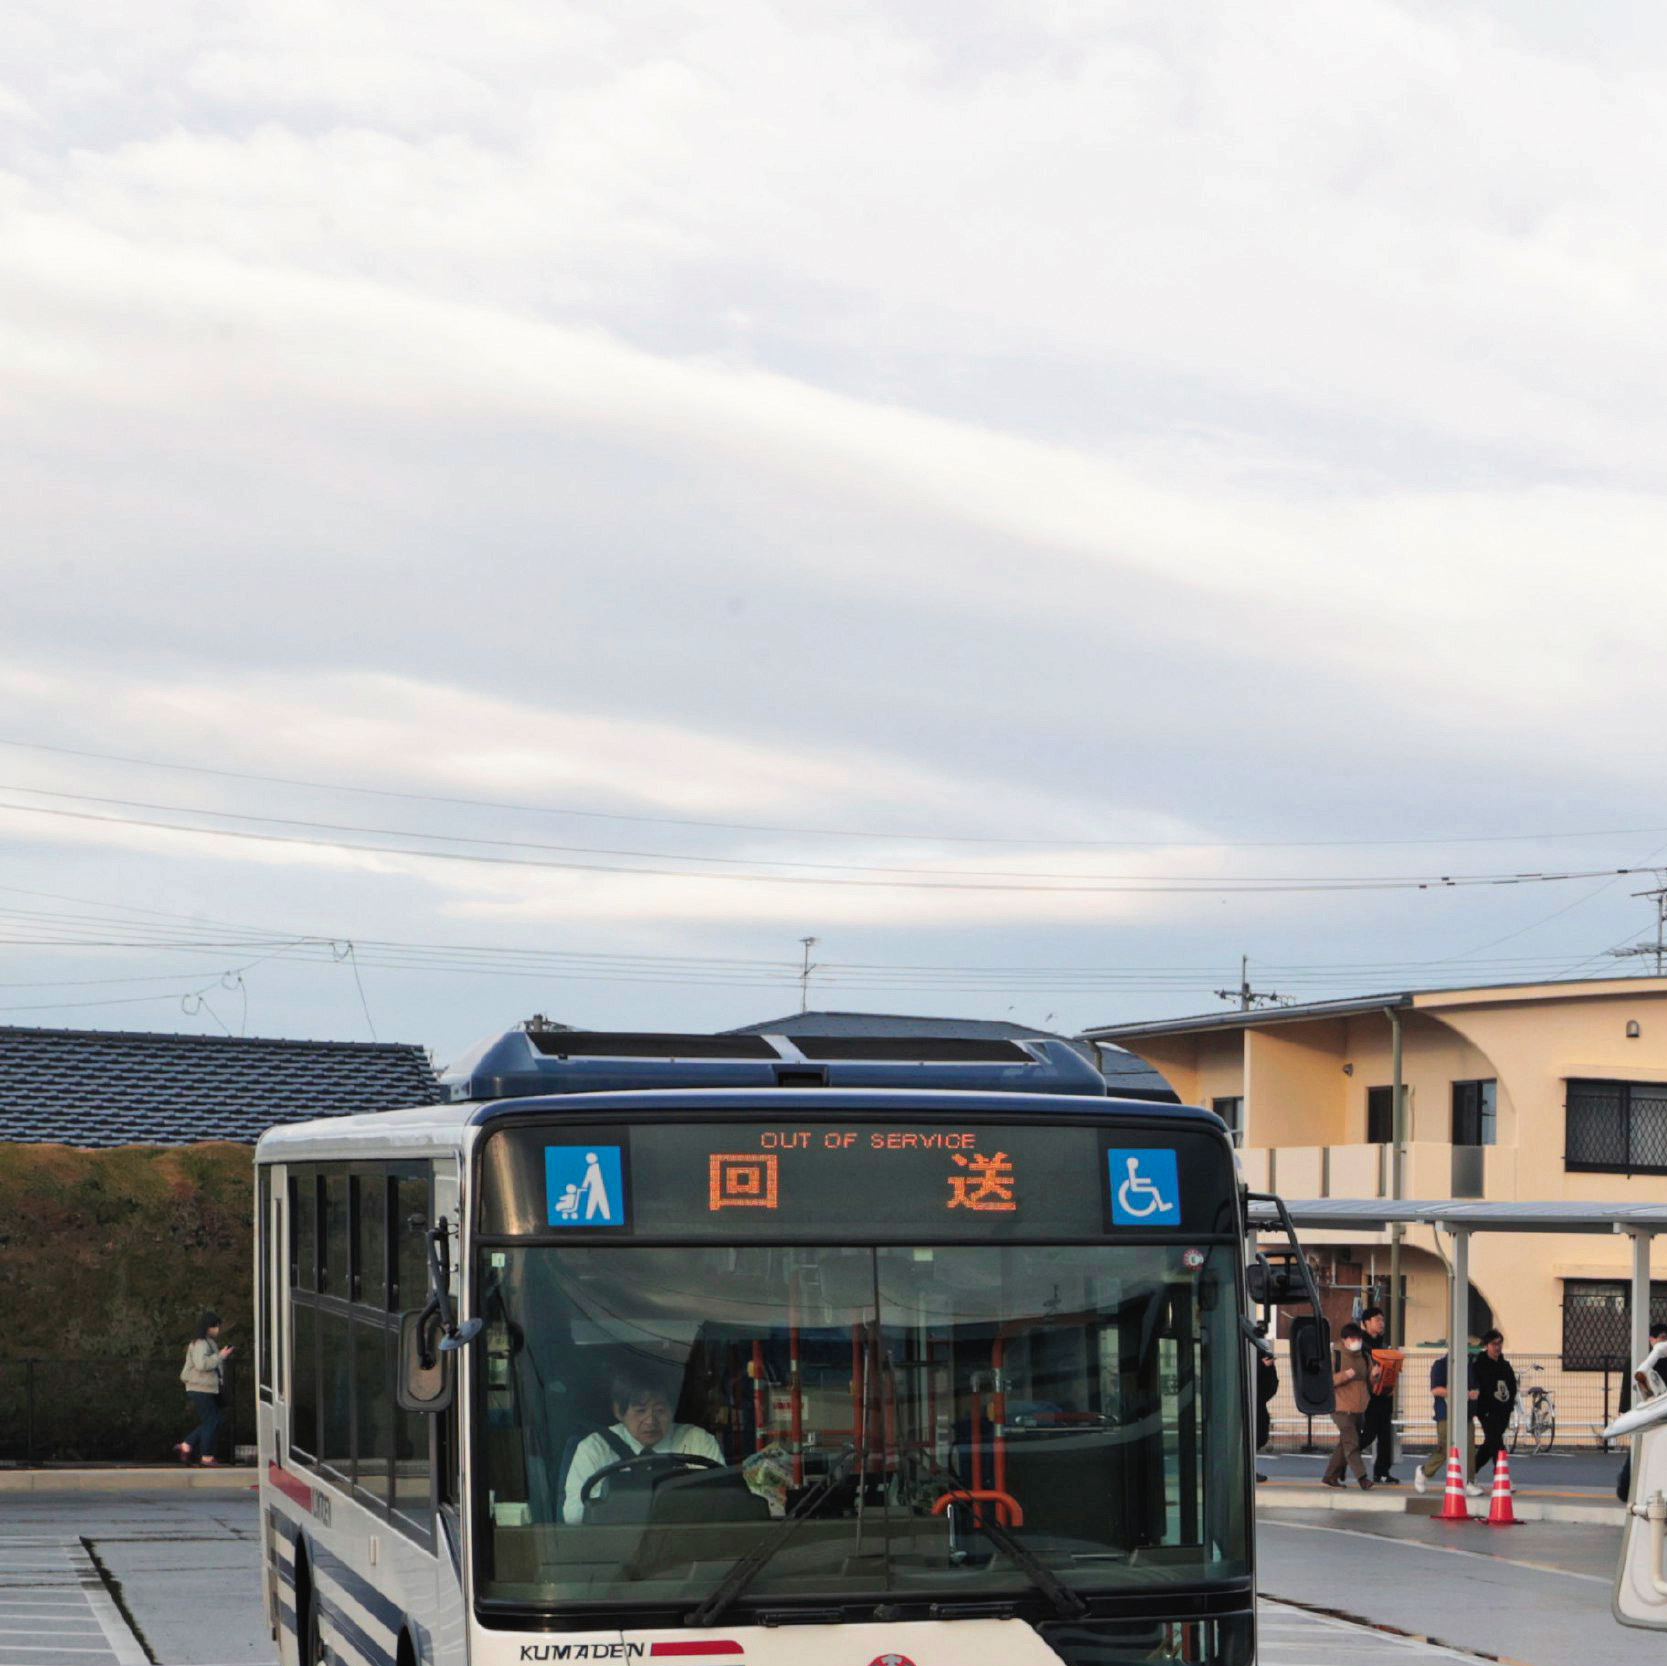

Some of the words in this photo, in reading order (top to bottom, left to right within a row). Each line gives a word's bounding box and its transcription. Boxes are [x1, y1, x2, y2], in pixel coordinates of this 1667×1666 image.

[761, 1132, 811, 1149] OUT
[824, 1133, 857, 1149] OF
[871, 1133, 976, 1149] SERVICE
[709, 1154, 778, 1211] 回
[947, 1151, 1017, 1211] 送
[520, 1642, 645, 1661] KUMADEN
